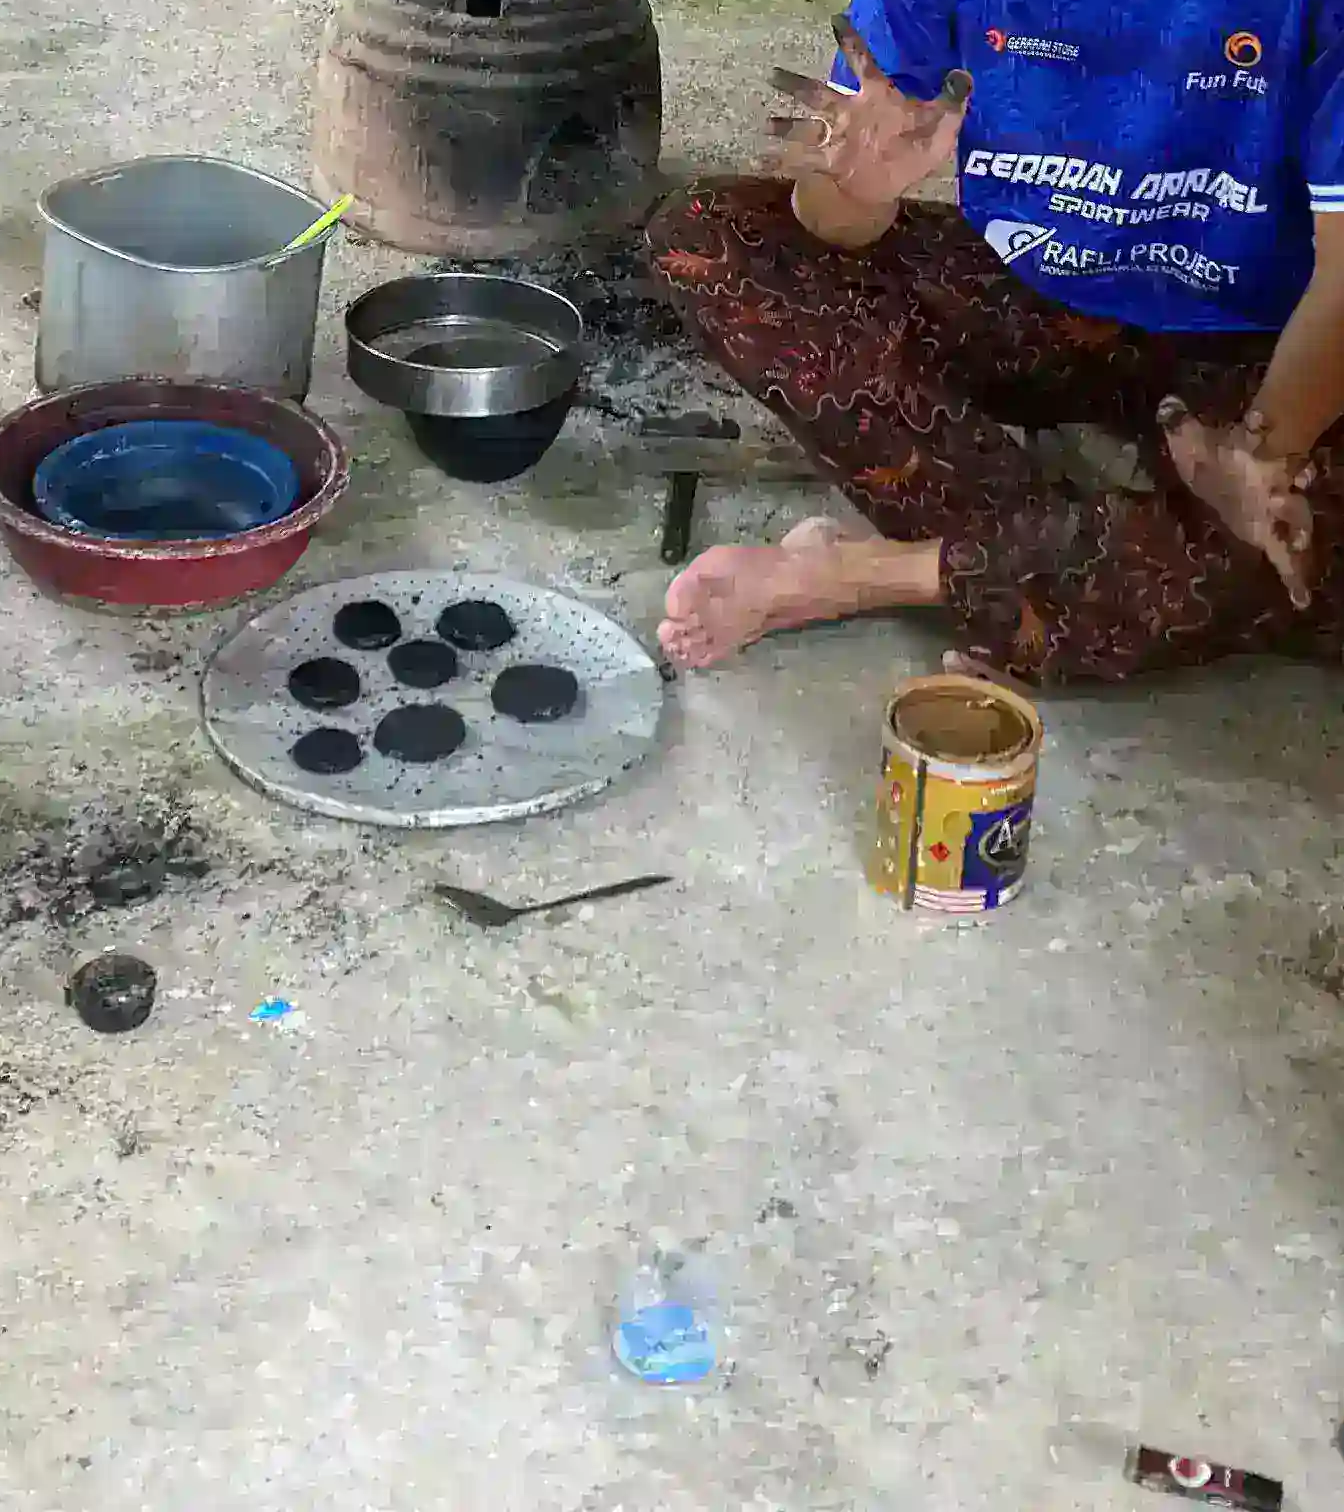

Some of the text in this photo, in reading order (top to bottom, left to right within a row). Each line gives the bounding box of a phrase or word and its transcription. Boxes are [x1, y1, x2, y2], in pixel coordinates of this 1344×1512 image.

[1185, 71, 1227, 90] Fun
[1048, 192, 1211, 226] SPORTWEAR
[1043, 240, 1122, 268] RAFLI
[1130, 242, 1240, 285] PROJECT
